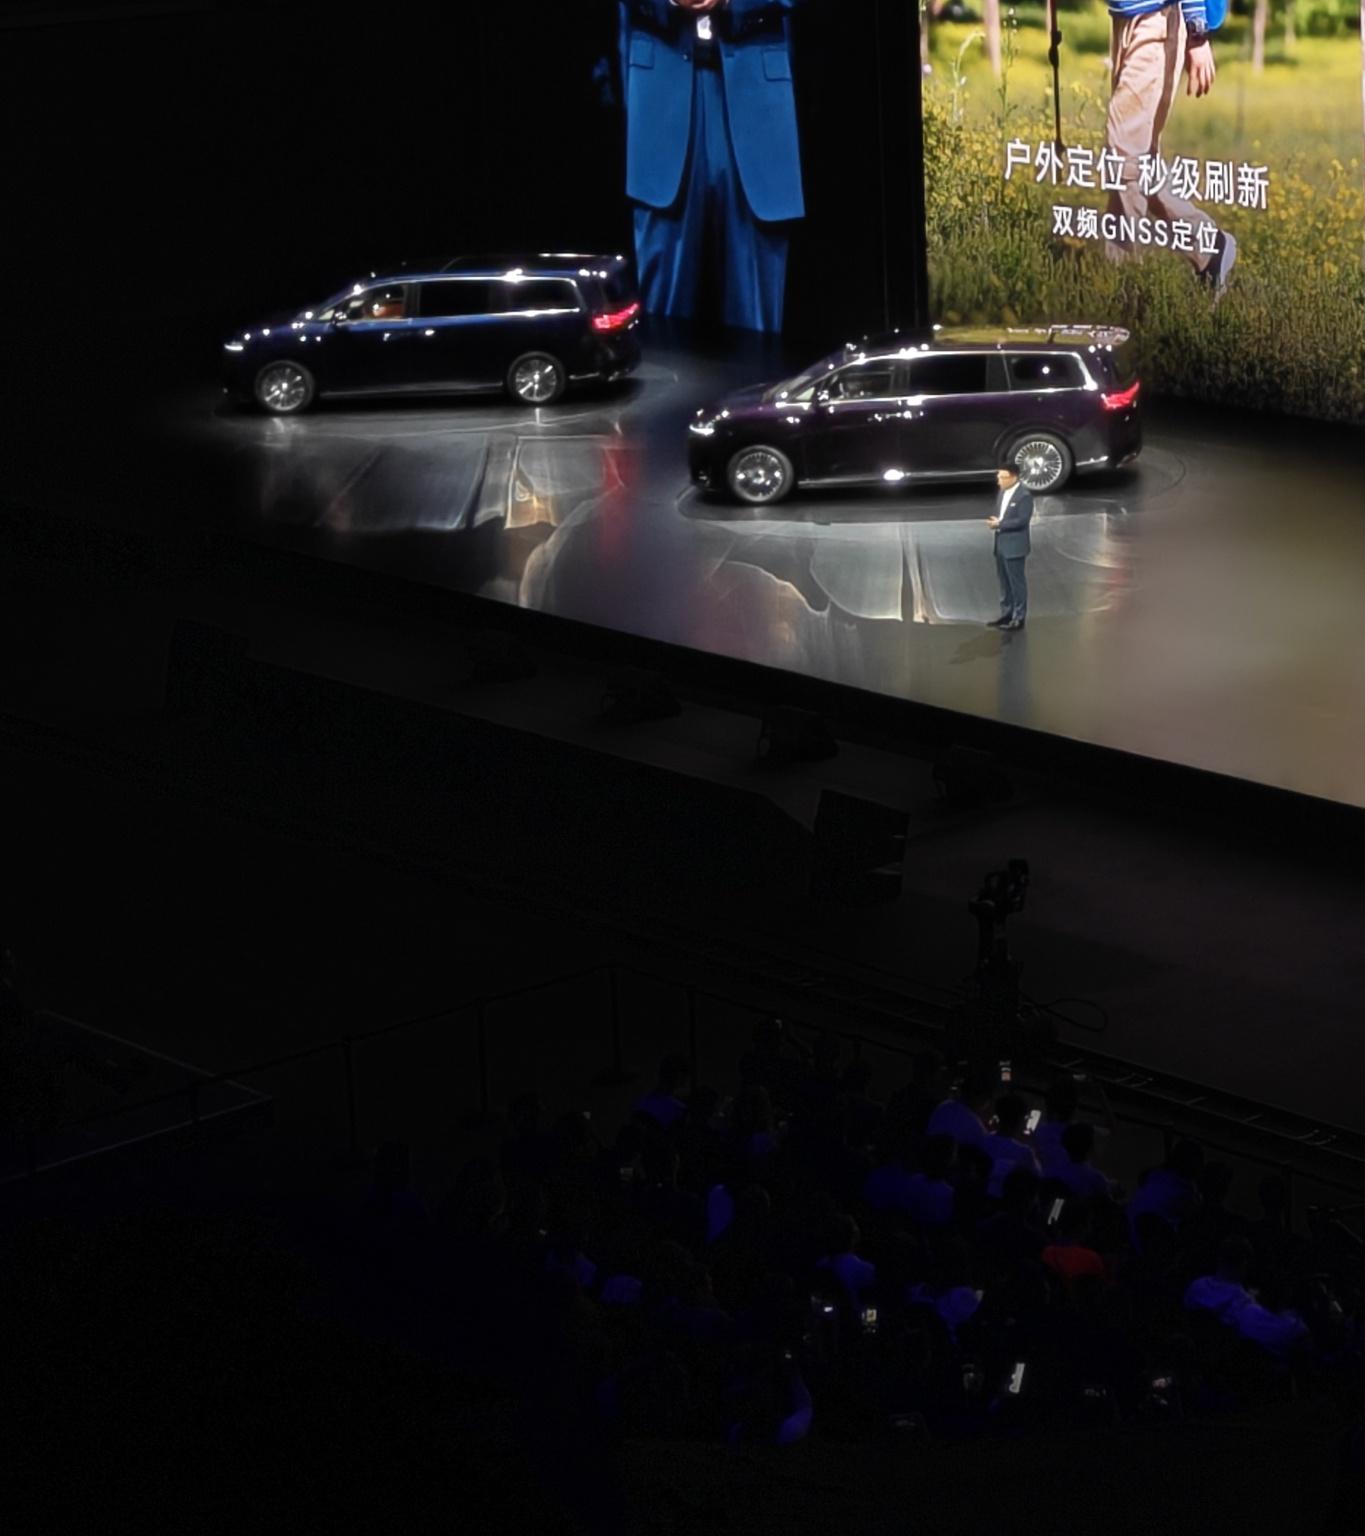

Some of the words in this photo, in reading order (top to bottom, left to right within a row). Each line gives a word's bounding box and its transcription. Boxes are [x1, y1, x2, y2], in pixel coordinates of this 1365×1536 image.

[1004, 138, 1127, 192] 户外定位
[1138, 152, 1270, 210] 秒级刷新
[1052, 205, 1220, 255] 双频GNSS定位
